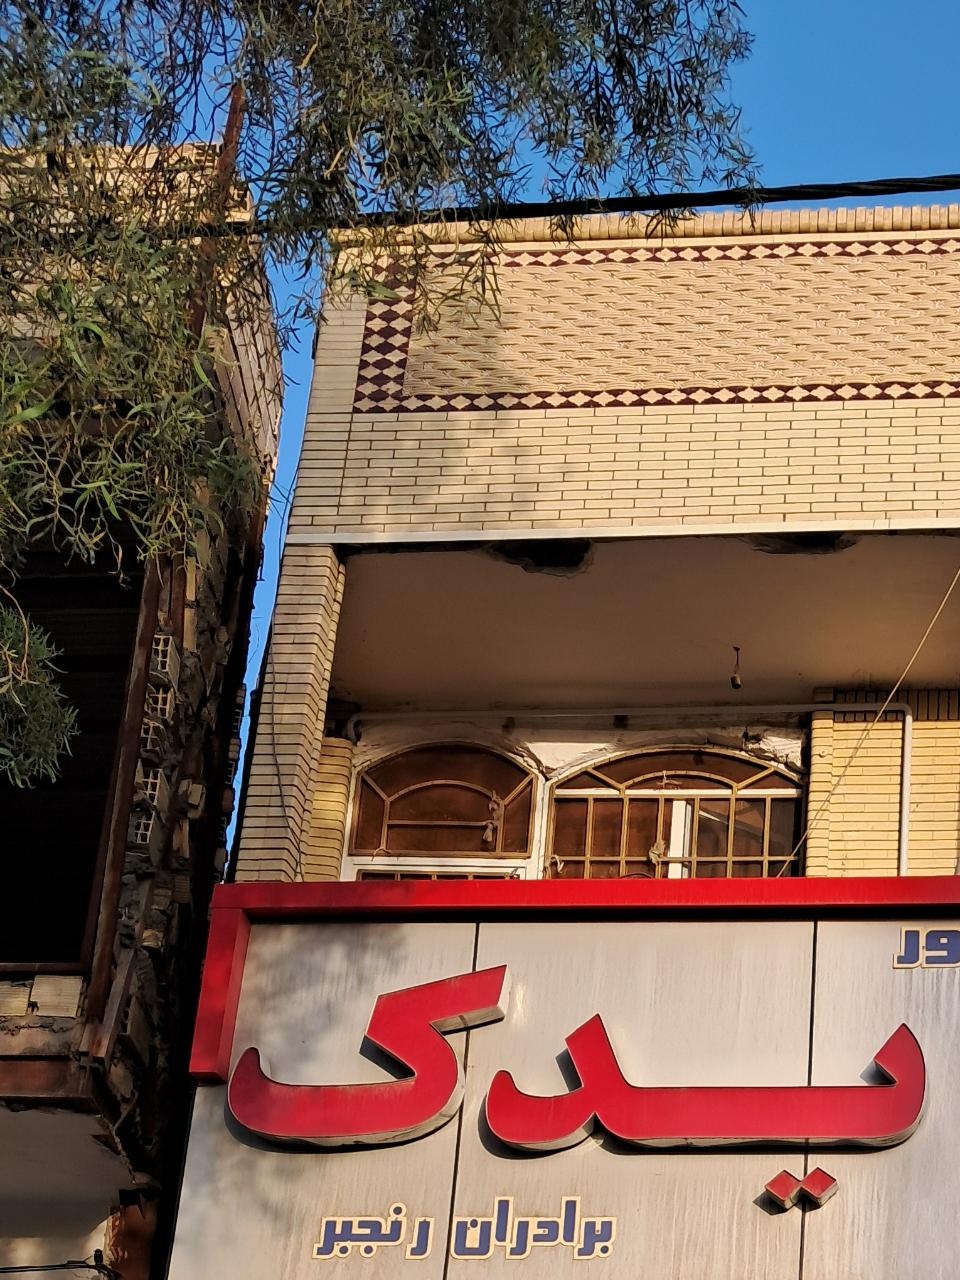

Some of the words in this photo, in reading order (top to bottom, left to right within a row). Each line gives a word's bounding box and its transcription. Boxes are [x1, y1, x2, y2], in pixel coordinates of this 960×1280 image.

[227, 964, 928, 1210] یدک
[312, 1201, 435, 1260] رنجبر
[450, 1195, 617, 1260] برادران
